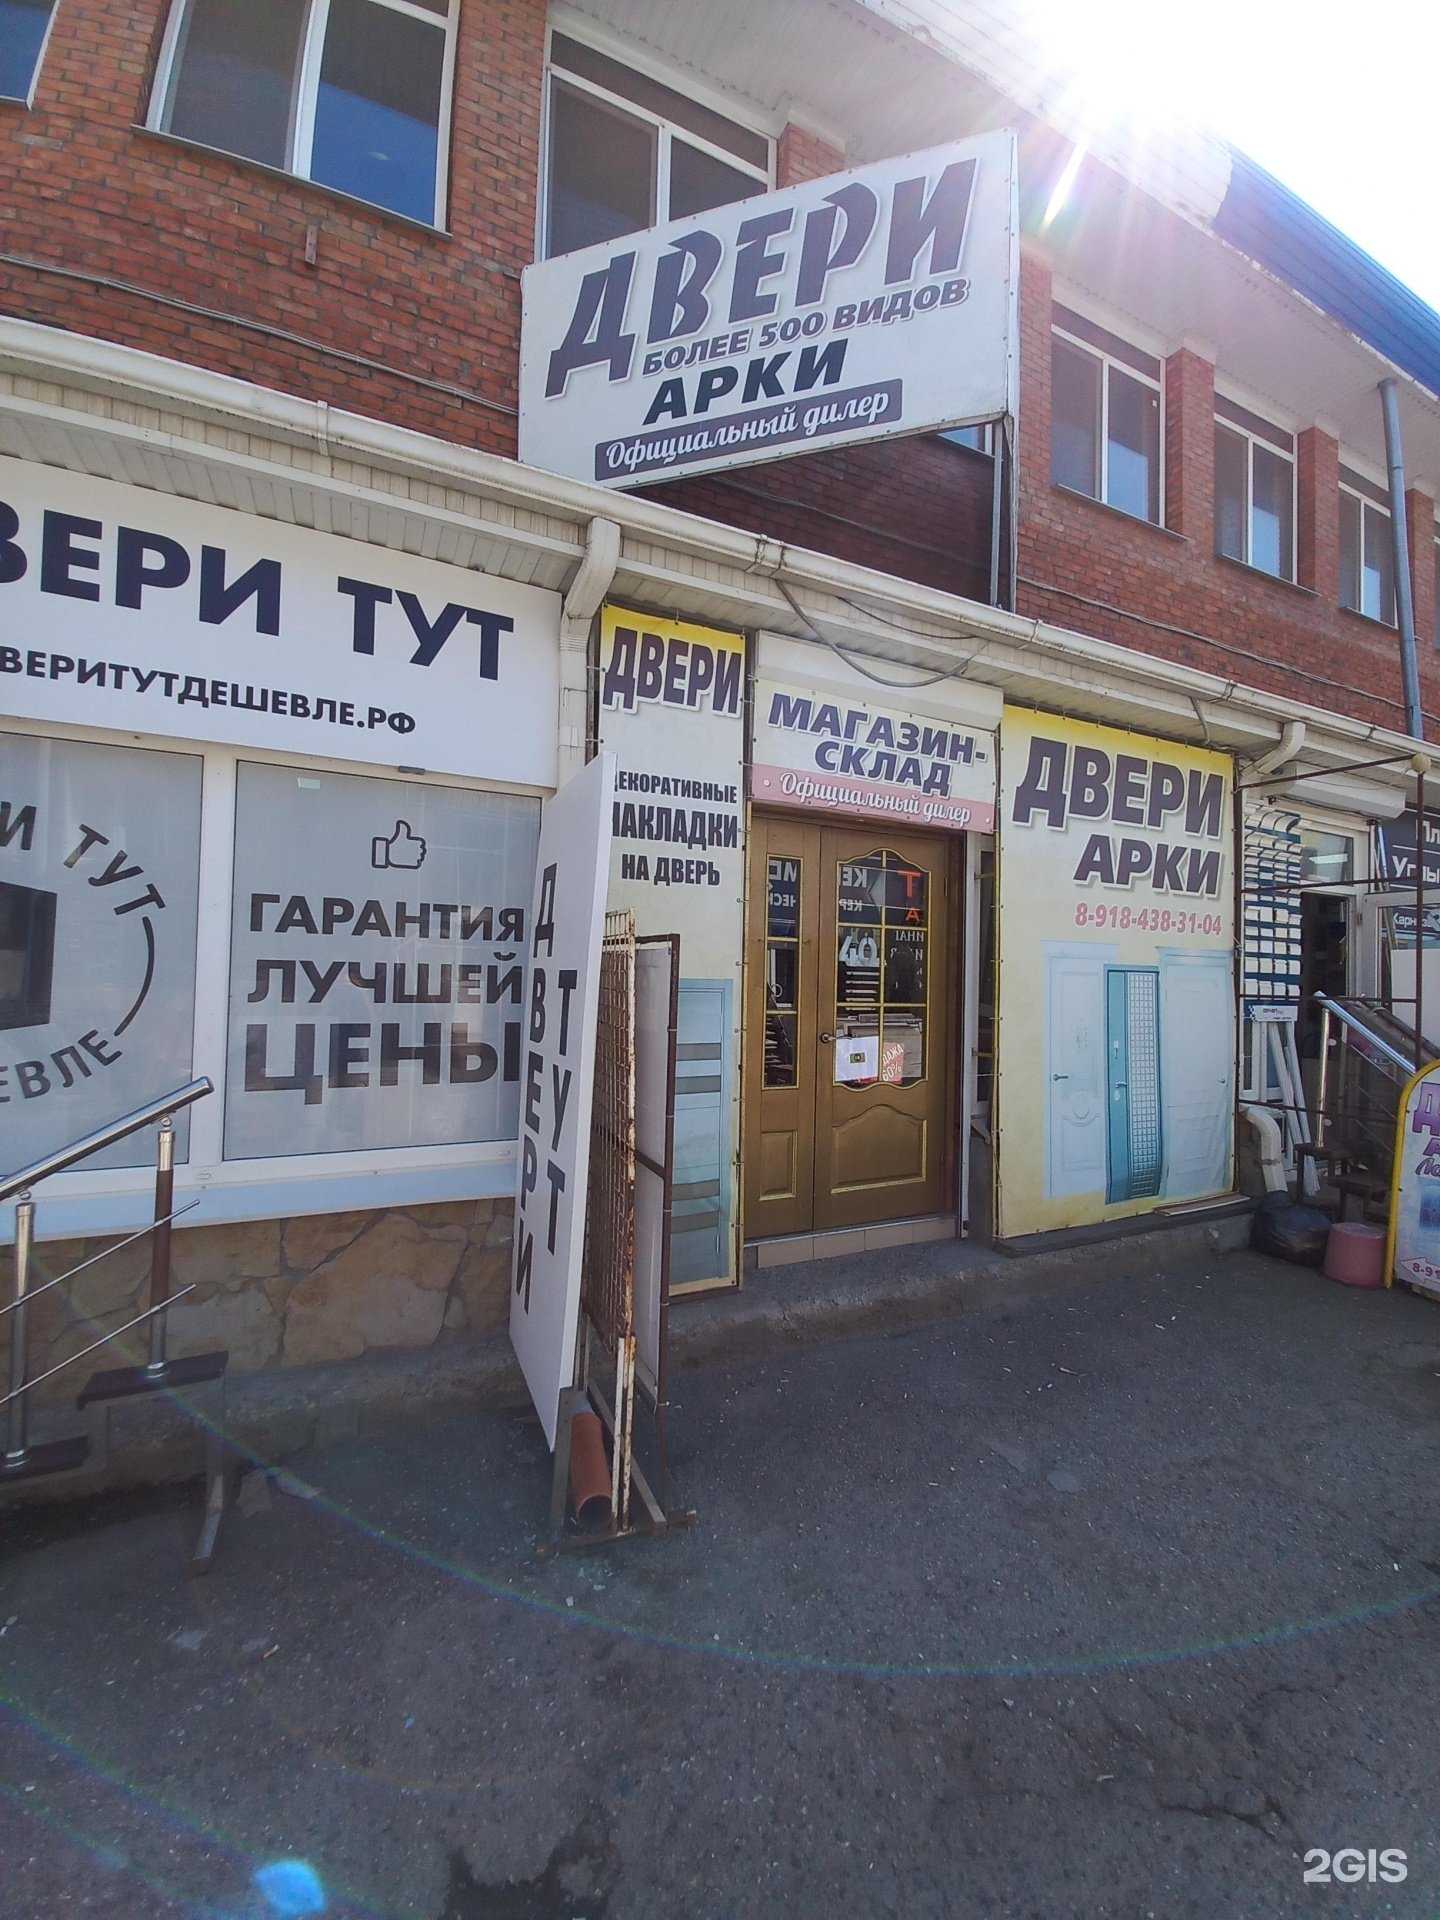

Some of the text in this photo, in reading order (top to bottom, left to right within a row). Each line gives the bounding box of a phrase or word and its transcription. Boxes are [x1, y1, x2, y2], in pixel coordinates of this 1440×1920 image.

[544, 157, 978, 399] ДВЕРИ
[642, 278, 971, 376] БОЛЕЕ 500 ВИДОВ
[642, 338, 849, 426] АРКИ
[606, 389, 889, 470] Официальный дилер
[337, 576, 515, 681] ТУТ
[601, 625, 743, 718] ДВЕРИ
[767, 692, 988, 765] МАГАЗИН-
[814, 740, 952, 799] СКЛАД
[615, 770, 737, 803] ЕКОРАТИВНЫЕ
[779, 771, 971, 828] Официальный дилер
[1011, 735, 1224, 839] ДВЕРИ
[63, 823, 166, 915] ТУТ
[621, 853, 721, 887] НА ДВЕРЬ
[1072, 833, 1222, 896] АРКИ
[249, 893, 525, 943] ГАРАНТИЯ
[1075, 902, 1222, 936] 8-918-438-31-04
[247, 951, 522, 1005] ЛУЧШЕЙ
[244, 1021, 521, 1105] ЦЕНЫ
[513, 862, 559, 1315] ДВЕРИ
[546, 969, 578, 1256] ТУТ
